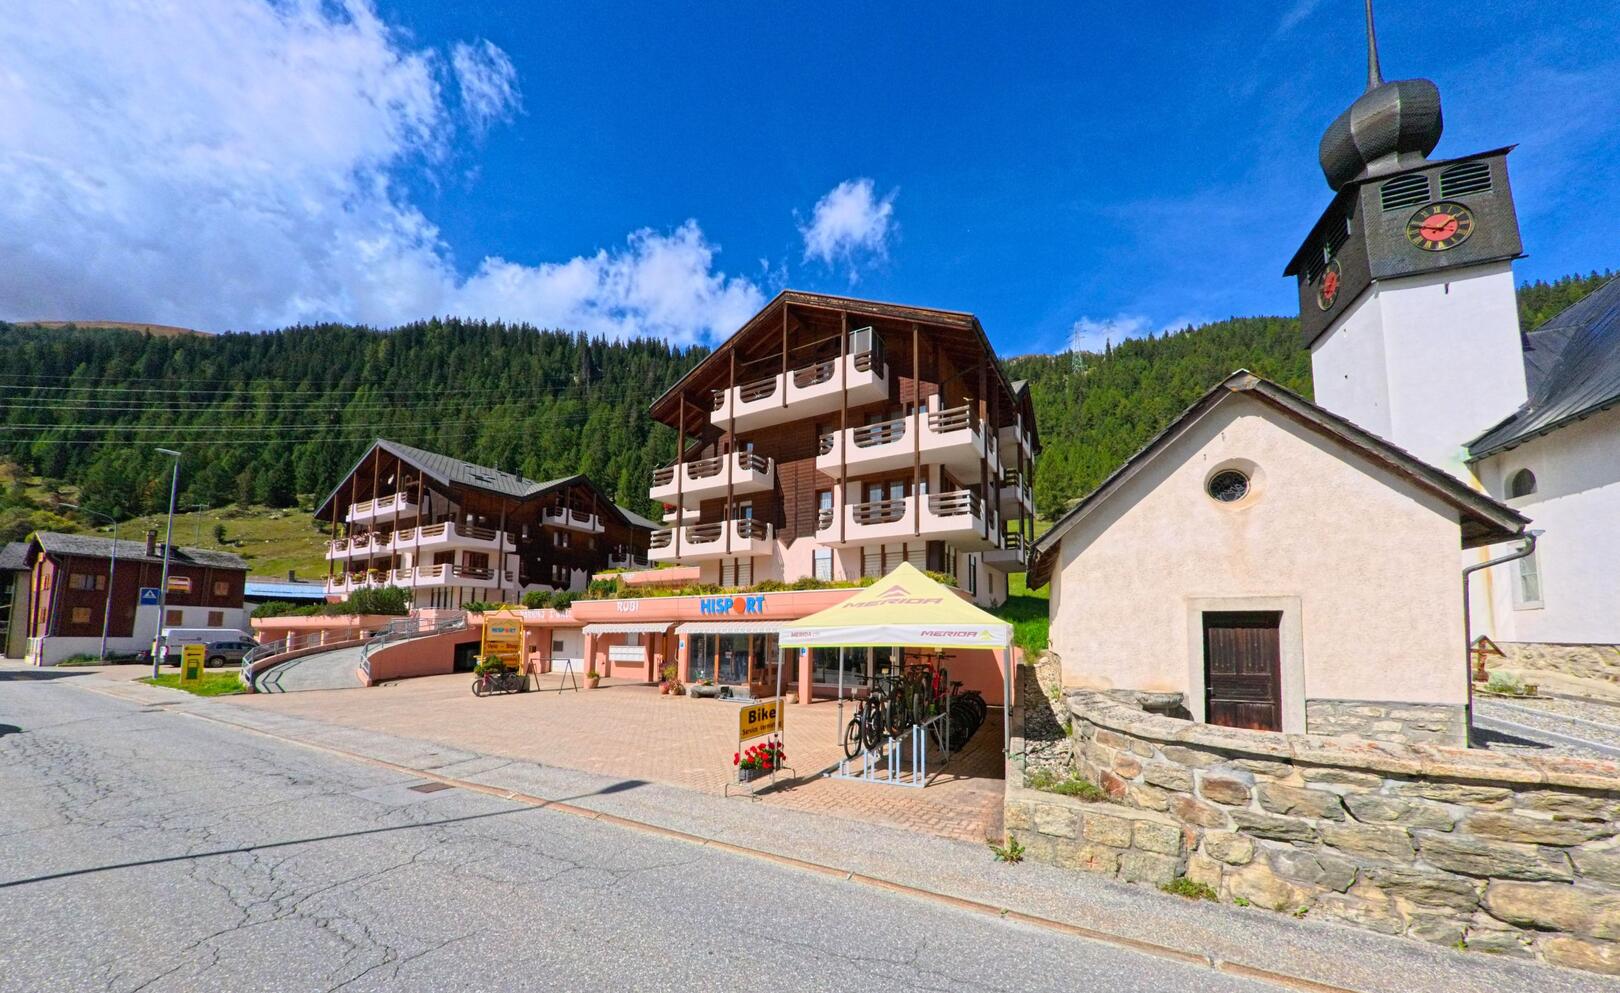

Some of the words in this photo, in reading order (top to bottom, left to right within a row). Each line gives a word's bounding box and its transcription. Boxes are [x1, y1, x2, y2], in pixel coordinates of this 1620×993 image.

[700, 596, 765, 615] HISPORT
[842, 597, 943, 609] MERIDA
[920, 630, 977, 638] MERIDA
[749, 707, 776, 724] Bike
